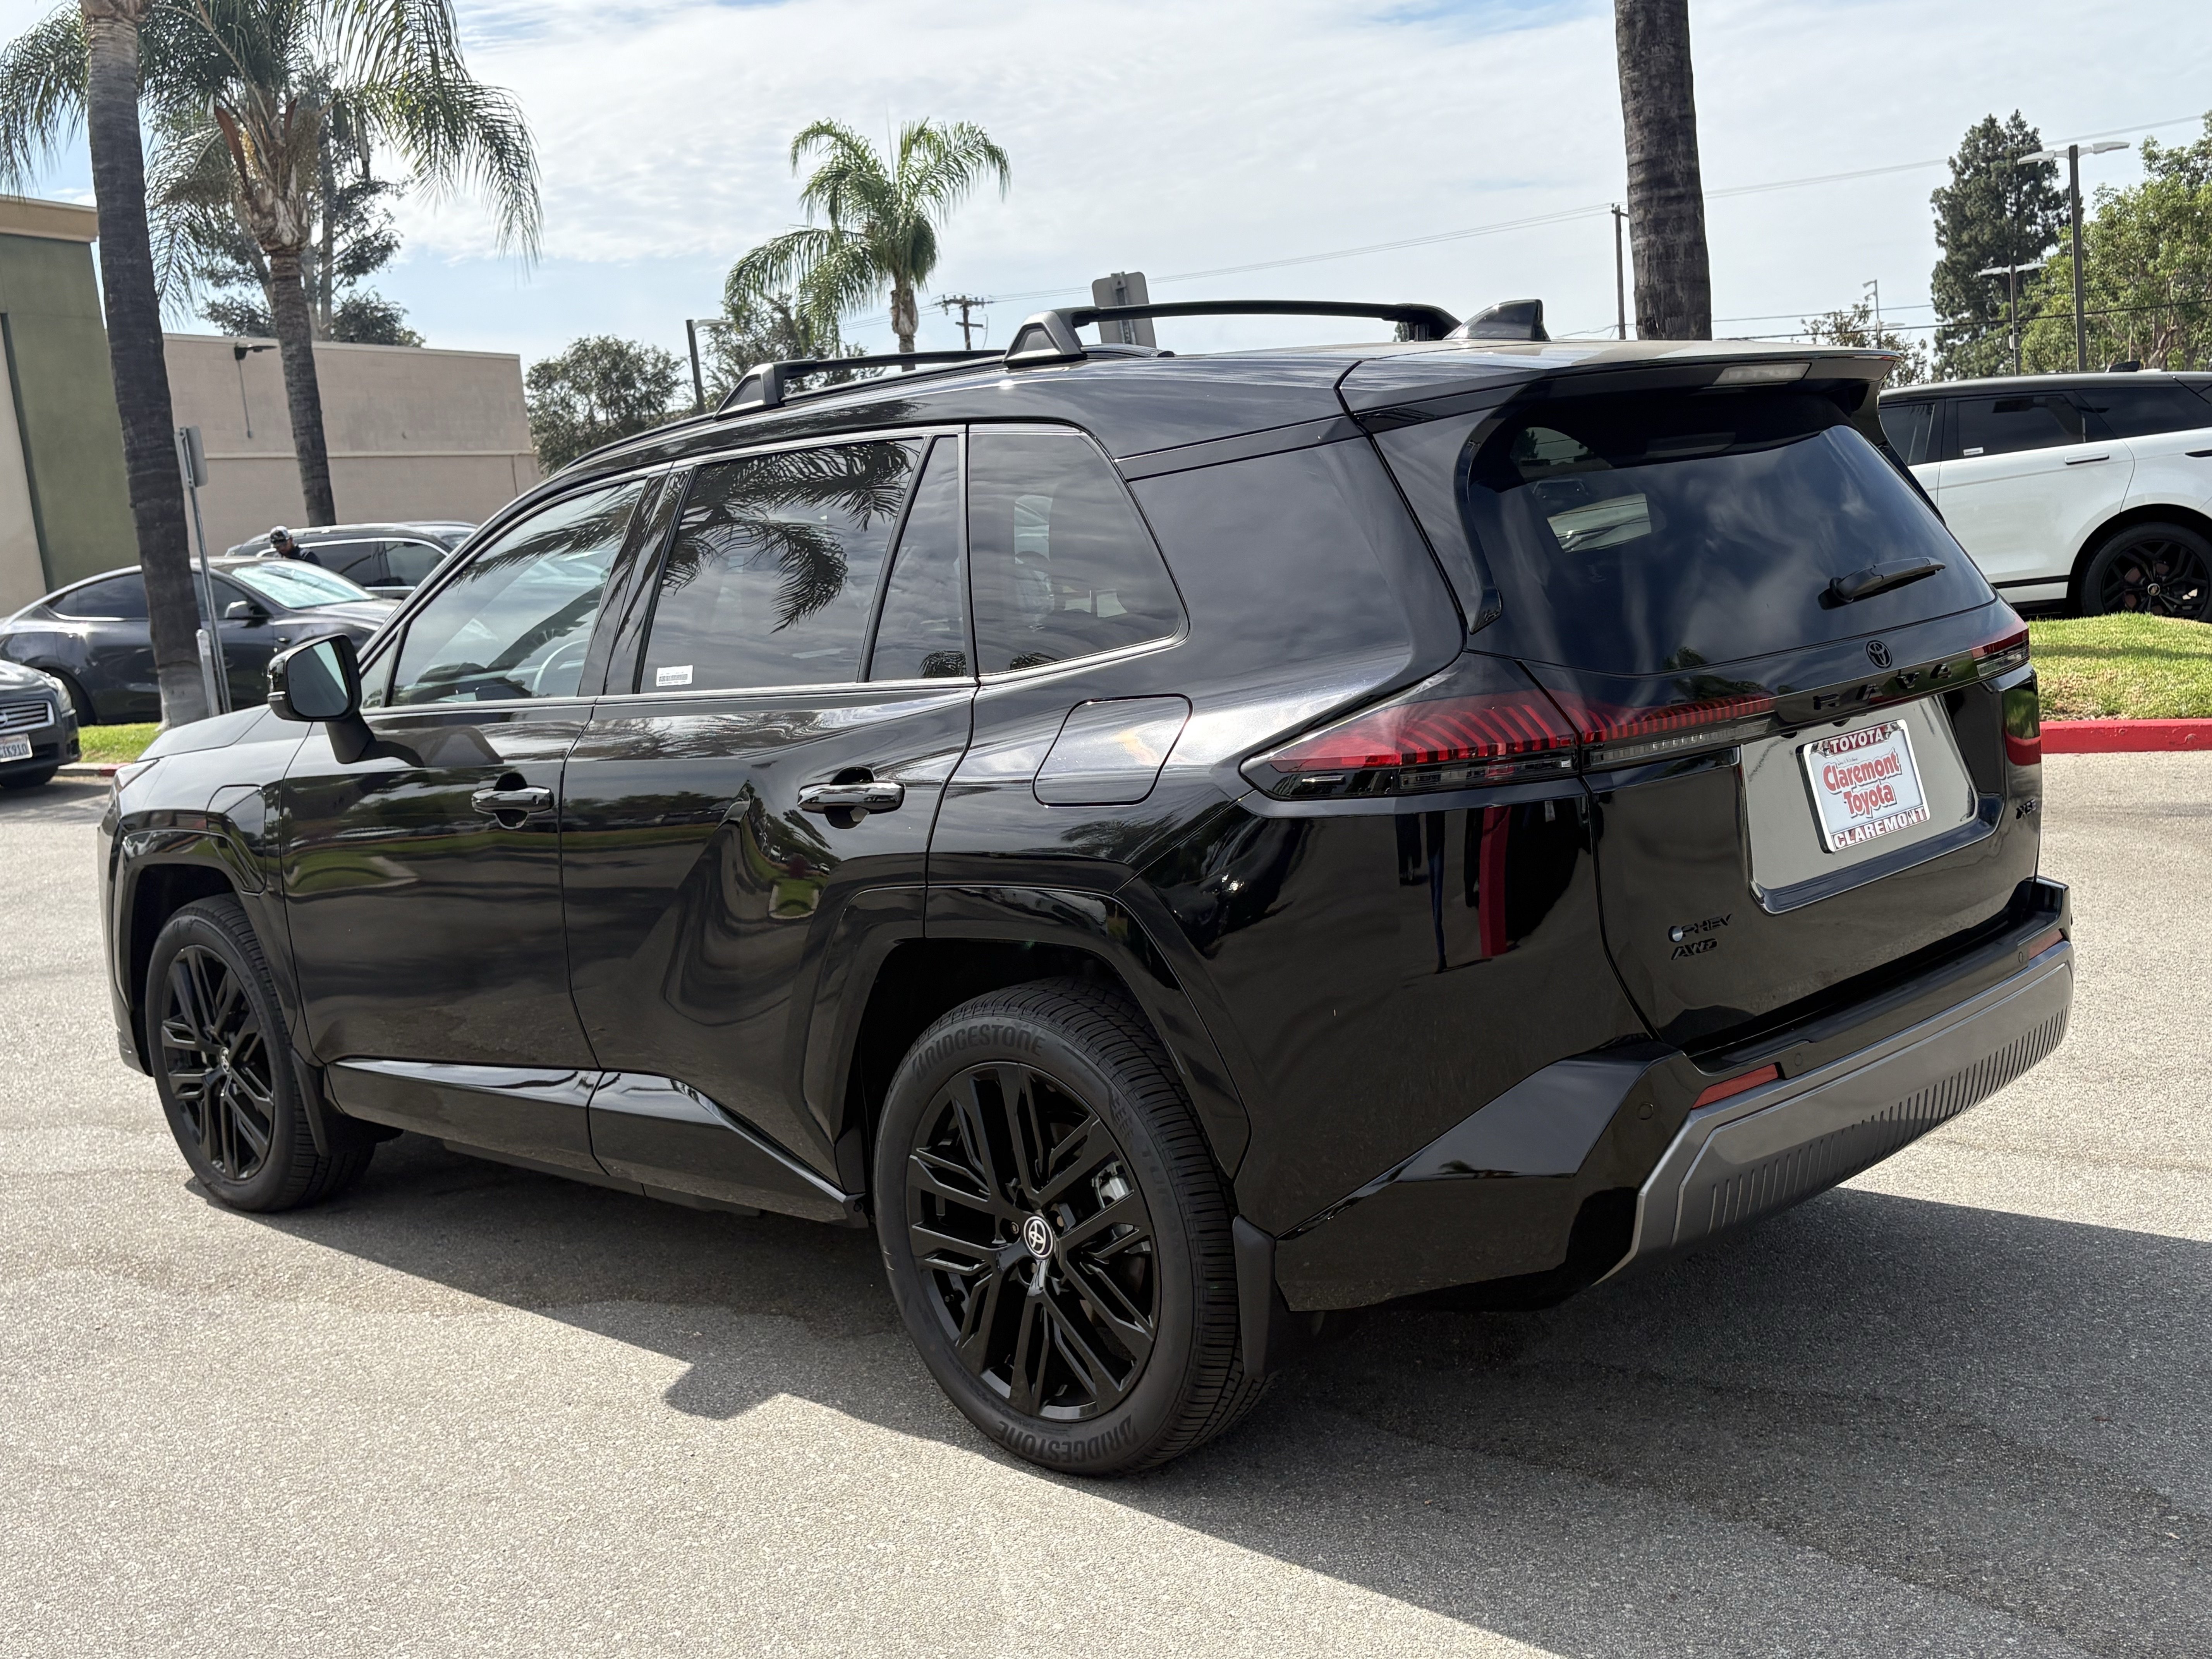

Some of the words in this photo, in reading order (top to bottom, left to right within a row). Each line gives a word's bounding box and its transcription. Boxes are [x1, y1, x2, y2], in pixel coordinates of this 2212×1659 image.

[1813, 663, 1952, 711] RAV4
[1830, 728, 1884, 754] TOYOTA
[1823, 751, 1900, 792] Claremont
[1843, 783, 1894, 815] Toyota
[1833, 807, 1927, 848] CLAREMONT
[1671, 938, 1717, 960] AWD
[912, 1024, 1046, 1084] BRIDGESTONE
[994, 1414, 1140, 1463] BRIDGESTONE
